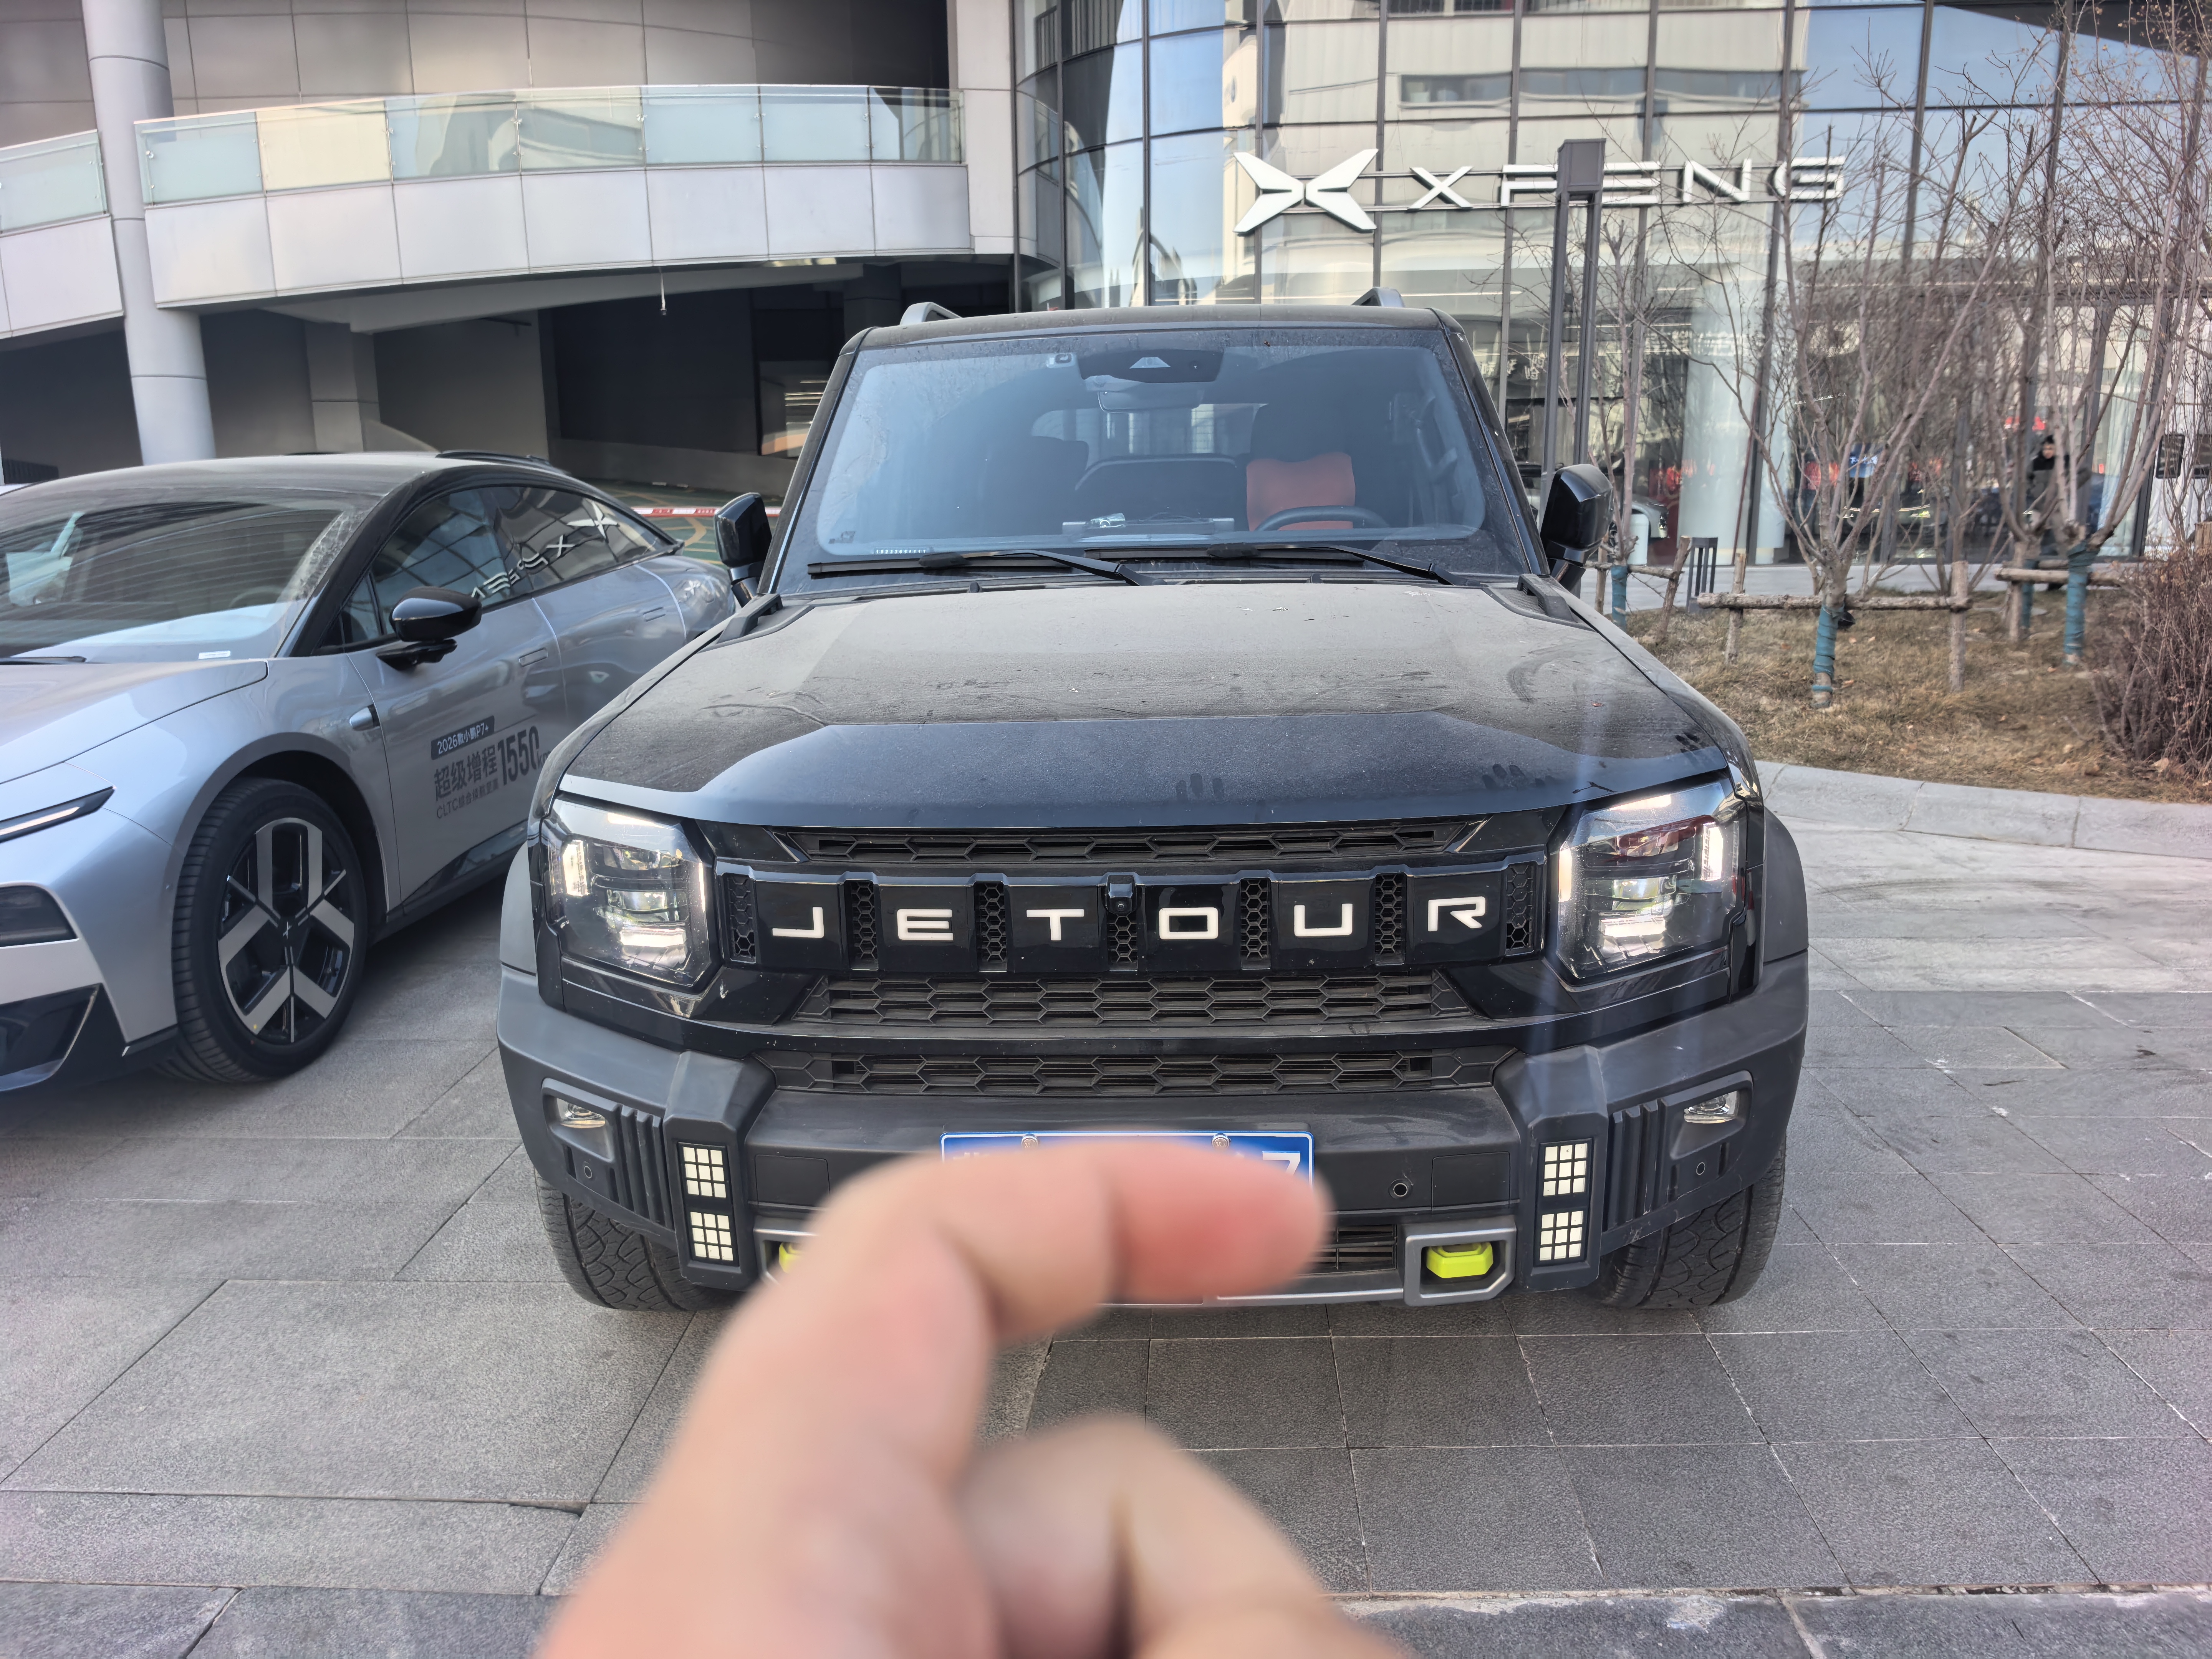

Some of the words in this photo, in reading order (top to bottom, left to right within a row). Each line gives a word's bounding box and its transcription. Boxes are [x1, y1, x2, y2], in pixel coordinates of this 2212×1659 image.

[434, 744, 498, 801] 超级增程
[772, 896, 1486, 941] JETOUR
